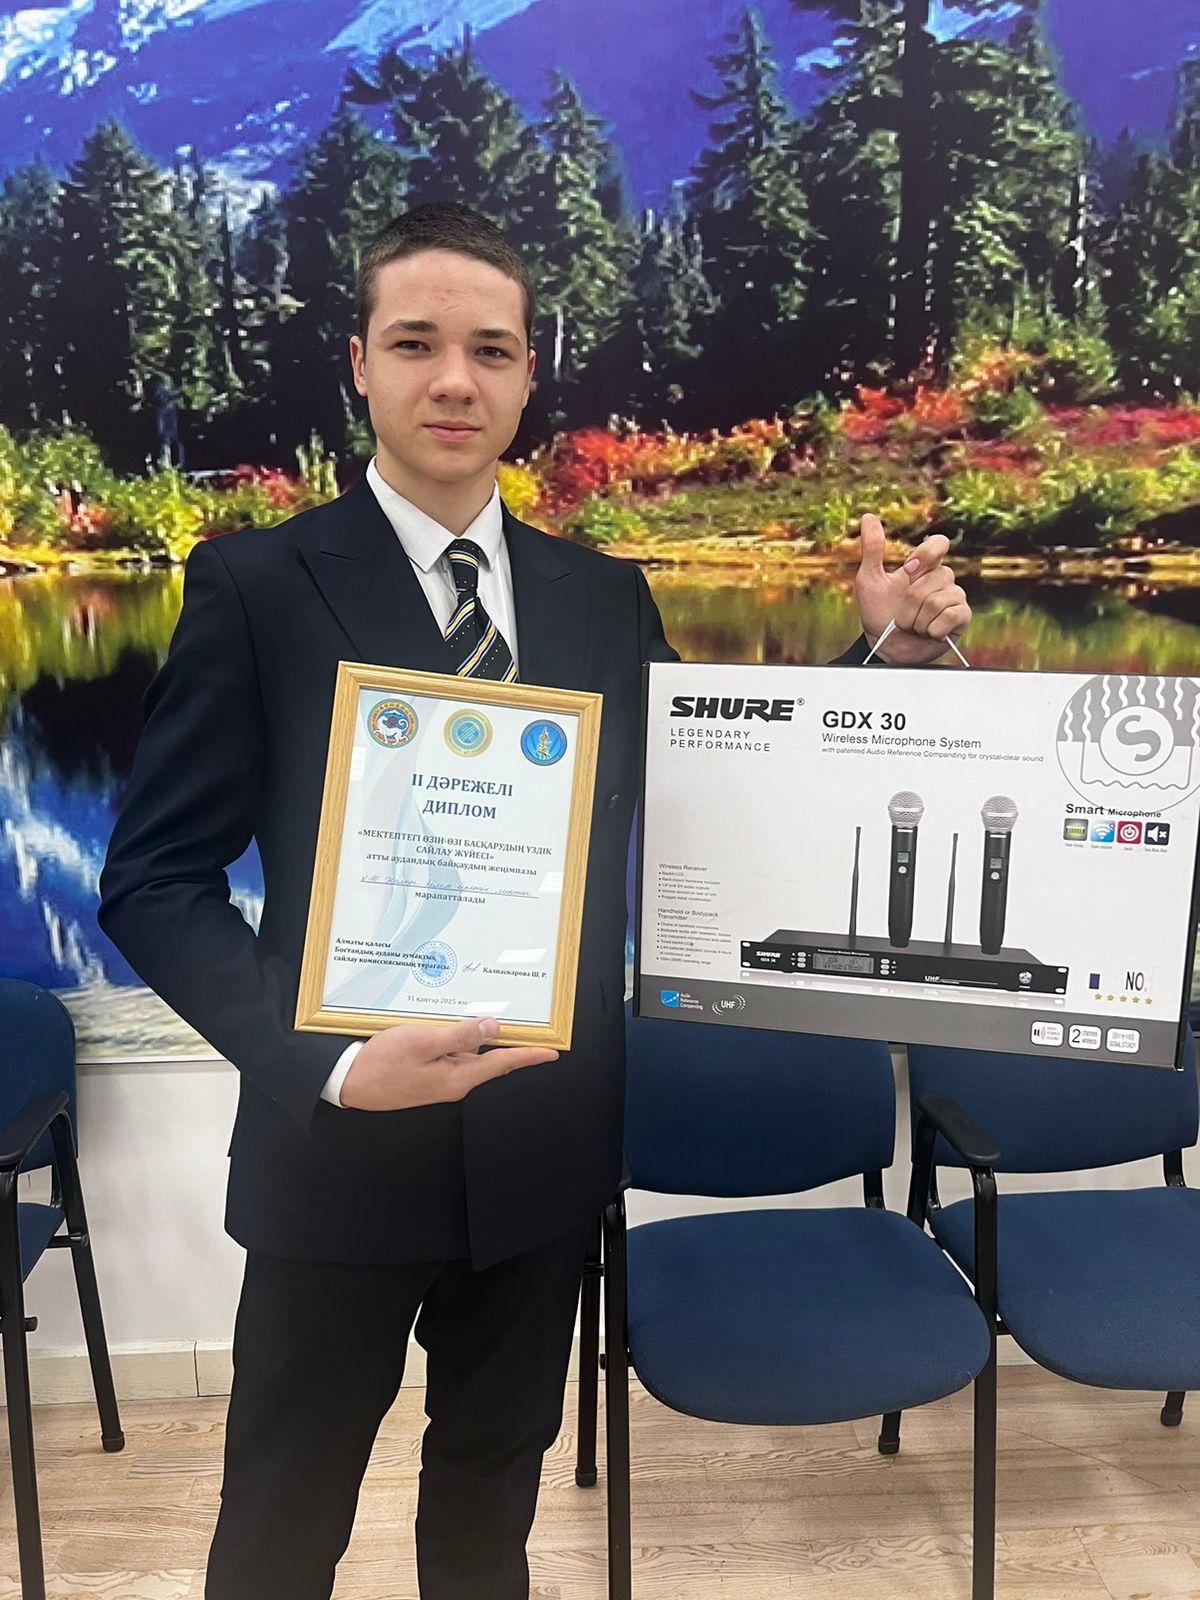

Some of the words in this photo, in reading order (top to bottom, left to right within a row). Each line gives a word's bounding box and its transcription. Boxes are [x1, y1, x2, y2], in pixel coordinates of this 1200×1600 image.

[822, 710, 873, 730] GDX
[880, 713, 906, 731] 30
[670, 728, 750, 739] LEGENDARY
[670, 739, 771, 752] PERFORMANCE
[822, 732, 868, 744] Wireless
[872, 734, 936, 748] Microphone
[939, 737, 982, 750] System
[866, 748, 886, 756] Audio
[887, 749, 922, 757] Reference
[923, 750, 967, 760] Companding
[426, 775, 513, 798] ДӘРЕЖЕЛІ
[422, 799, 497, 820] ДИПЛОМ
[1065, 803, 1105, 815] Smart
[1107, 808, 1162, 819] Microphone
[416, 845, 453, 856] САЙЛАУ
[463, 838, 525, 854] БАСҚАРУДЫҢ
[366, 853, 390, 862] атты
[391, 856, 436, 867] аудандық
[437, 859, 487, 871] байқаудың
[488, 865, 537, 876] жеңімпазы
[414, 891, 486, 904] марапатталады
[657, 907, 684, 915] Handheld
[691, 910, 719, 918] Bodypack
[336, 937, 364, 946] Алматы
[364, 940, 391, 949] қаласы
[334, 946, 374, 956] Бостандық
[375, 950, 402, 959] ауданы
[333, 955, 358, 963] сайлау
[359, 957, 416, 968] комиссиясының
[721, 1000, 736, 1009] UHF
[1072, 1028, 1081, 1043] 2
